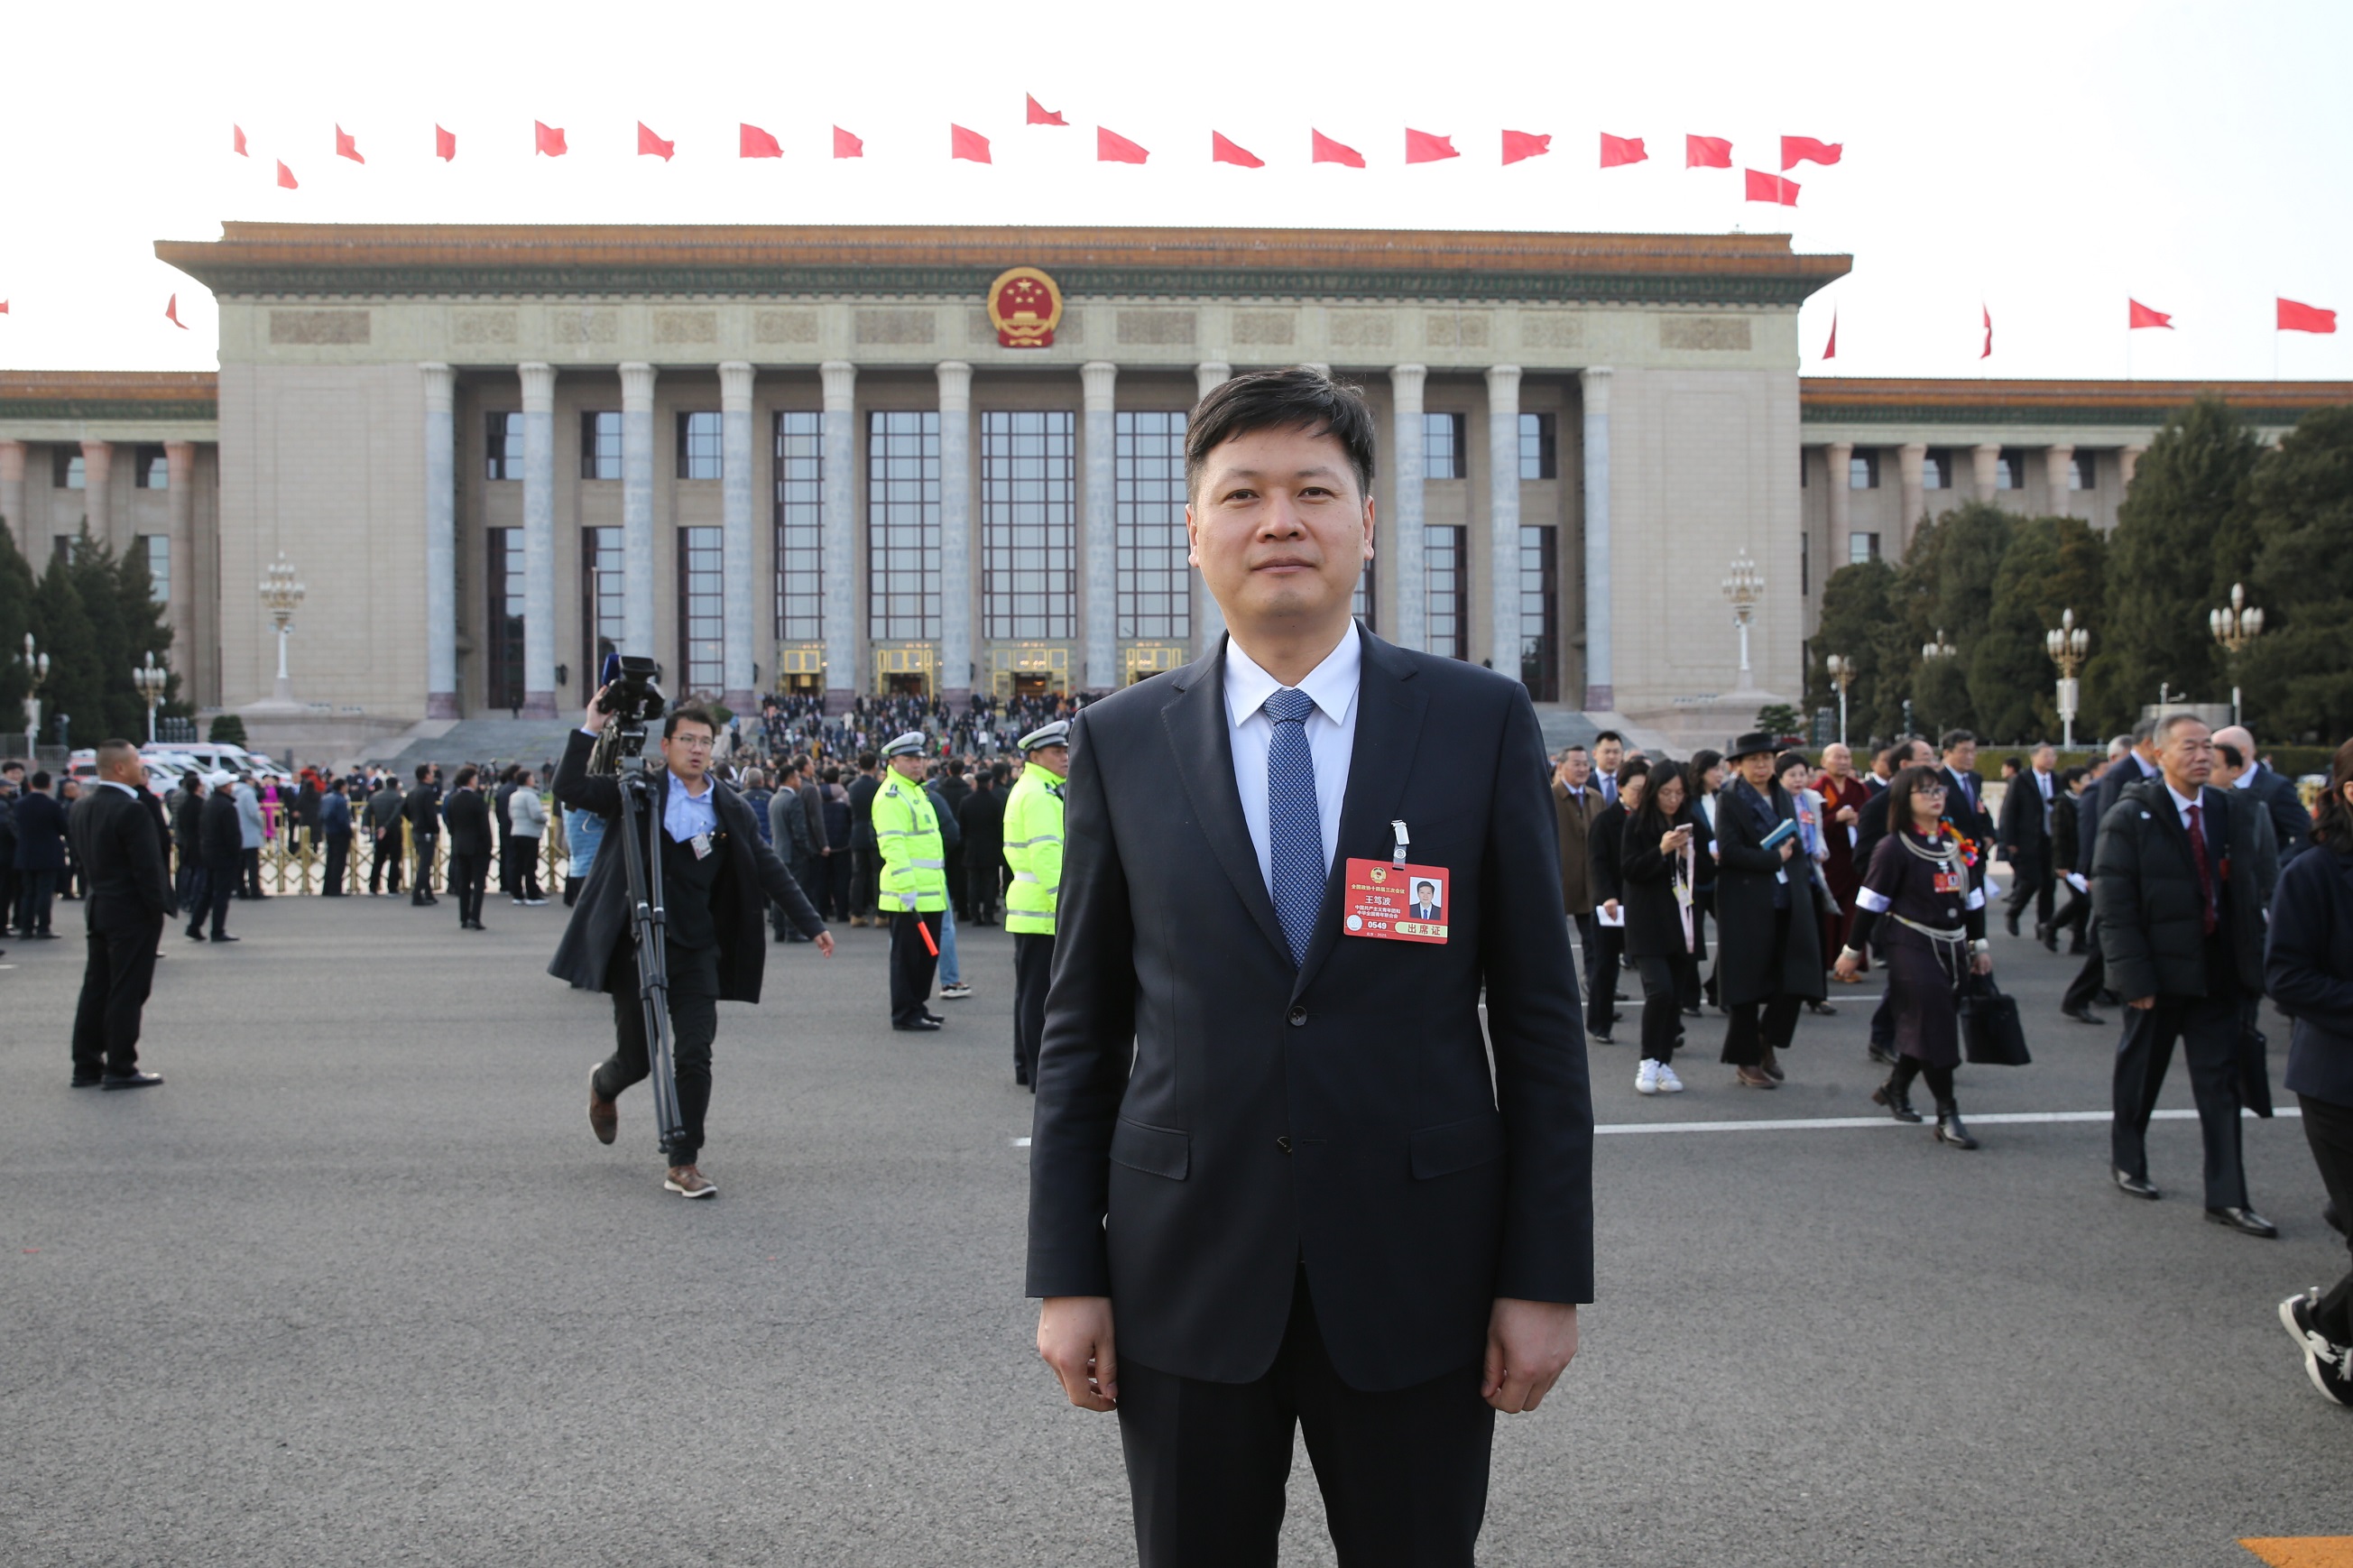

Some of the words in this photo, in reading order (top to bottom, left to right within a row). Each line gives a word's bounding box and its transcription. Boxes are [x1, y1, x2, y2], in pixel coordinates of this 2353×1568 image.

[1365, 895, 1391, 906] 王笃波
[1368, 921, 1387, 929] 0549
[1407, 924, 1441, 936] 出席证
